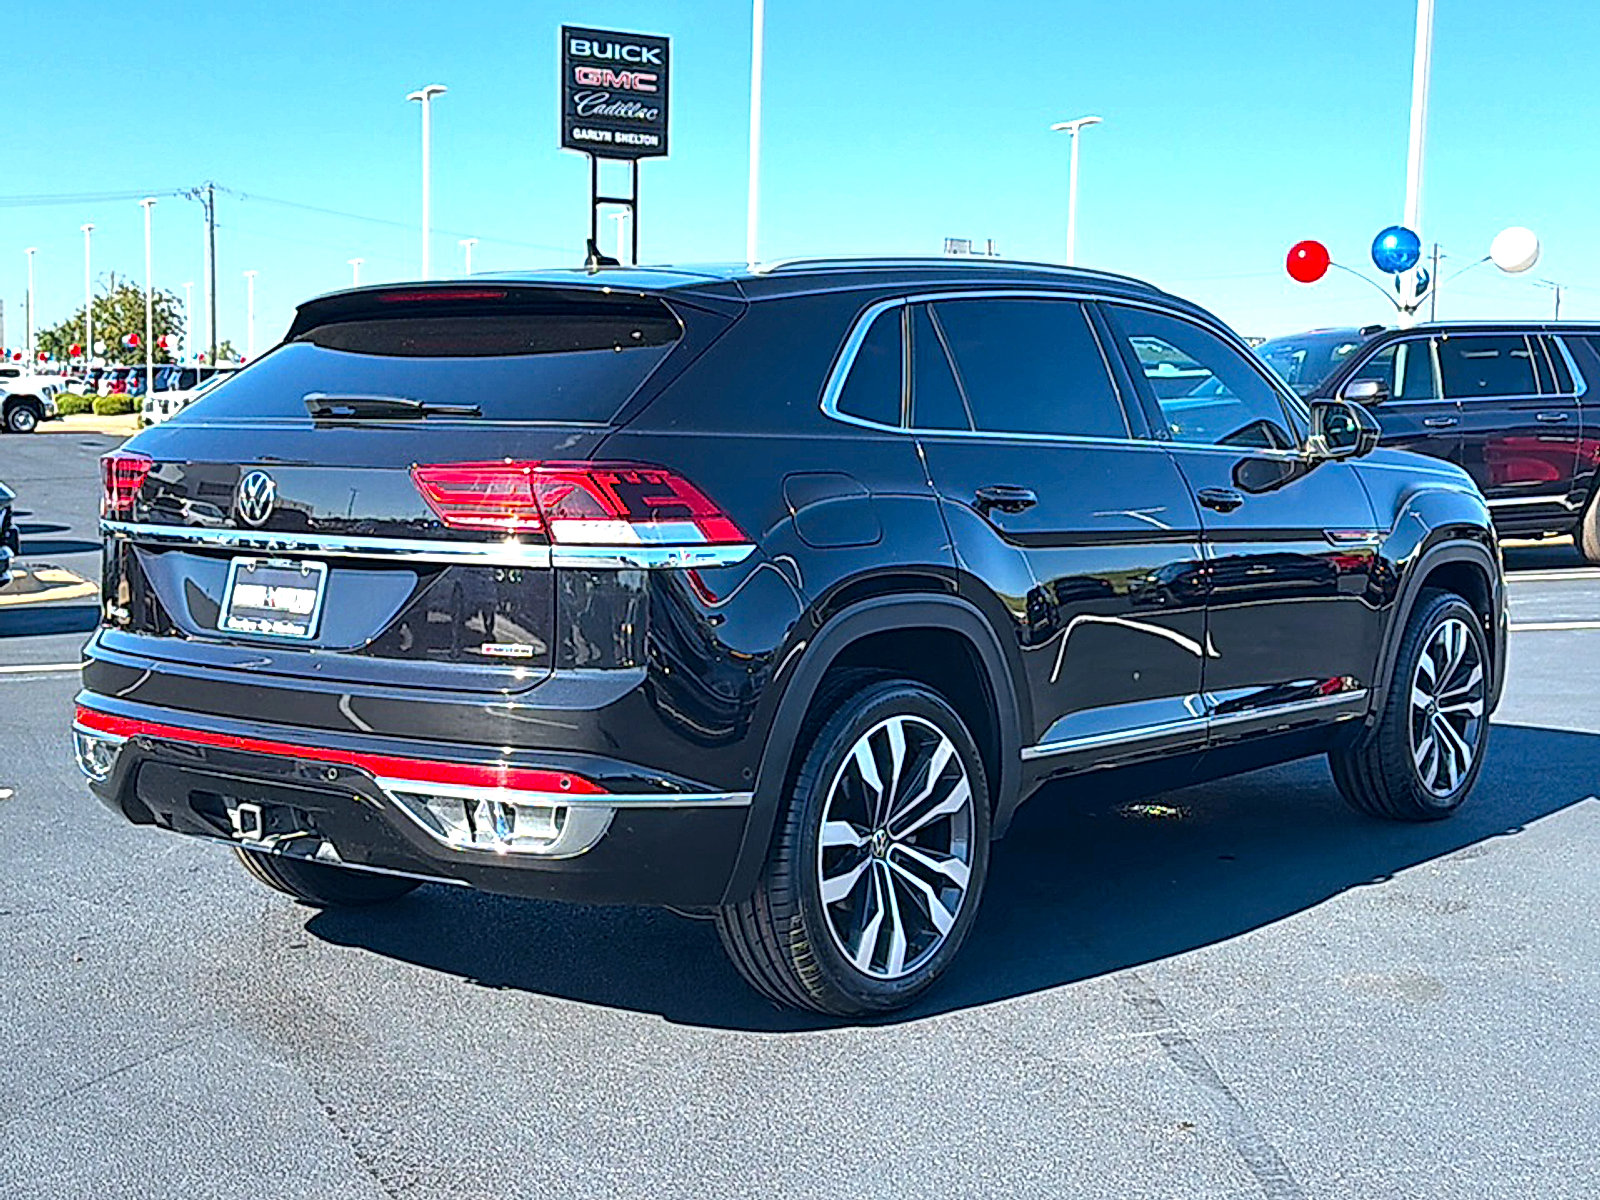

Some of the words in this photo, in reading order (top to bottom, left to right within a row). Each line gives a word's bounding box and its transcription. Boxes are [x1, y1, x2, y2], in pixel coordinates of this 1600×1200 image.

[570, 39, 662, 64] BUICK
[574, 66, 658, 92] GMC
[573, 91, 659, 121] Cadillac
